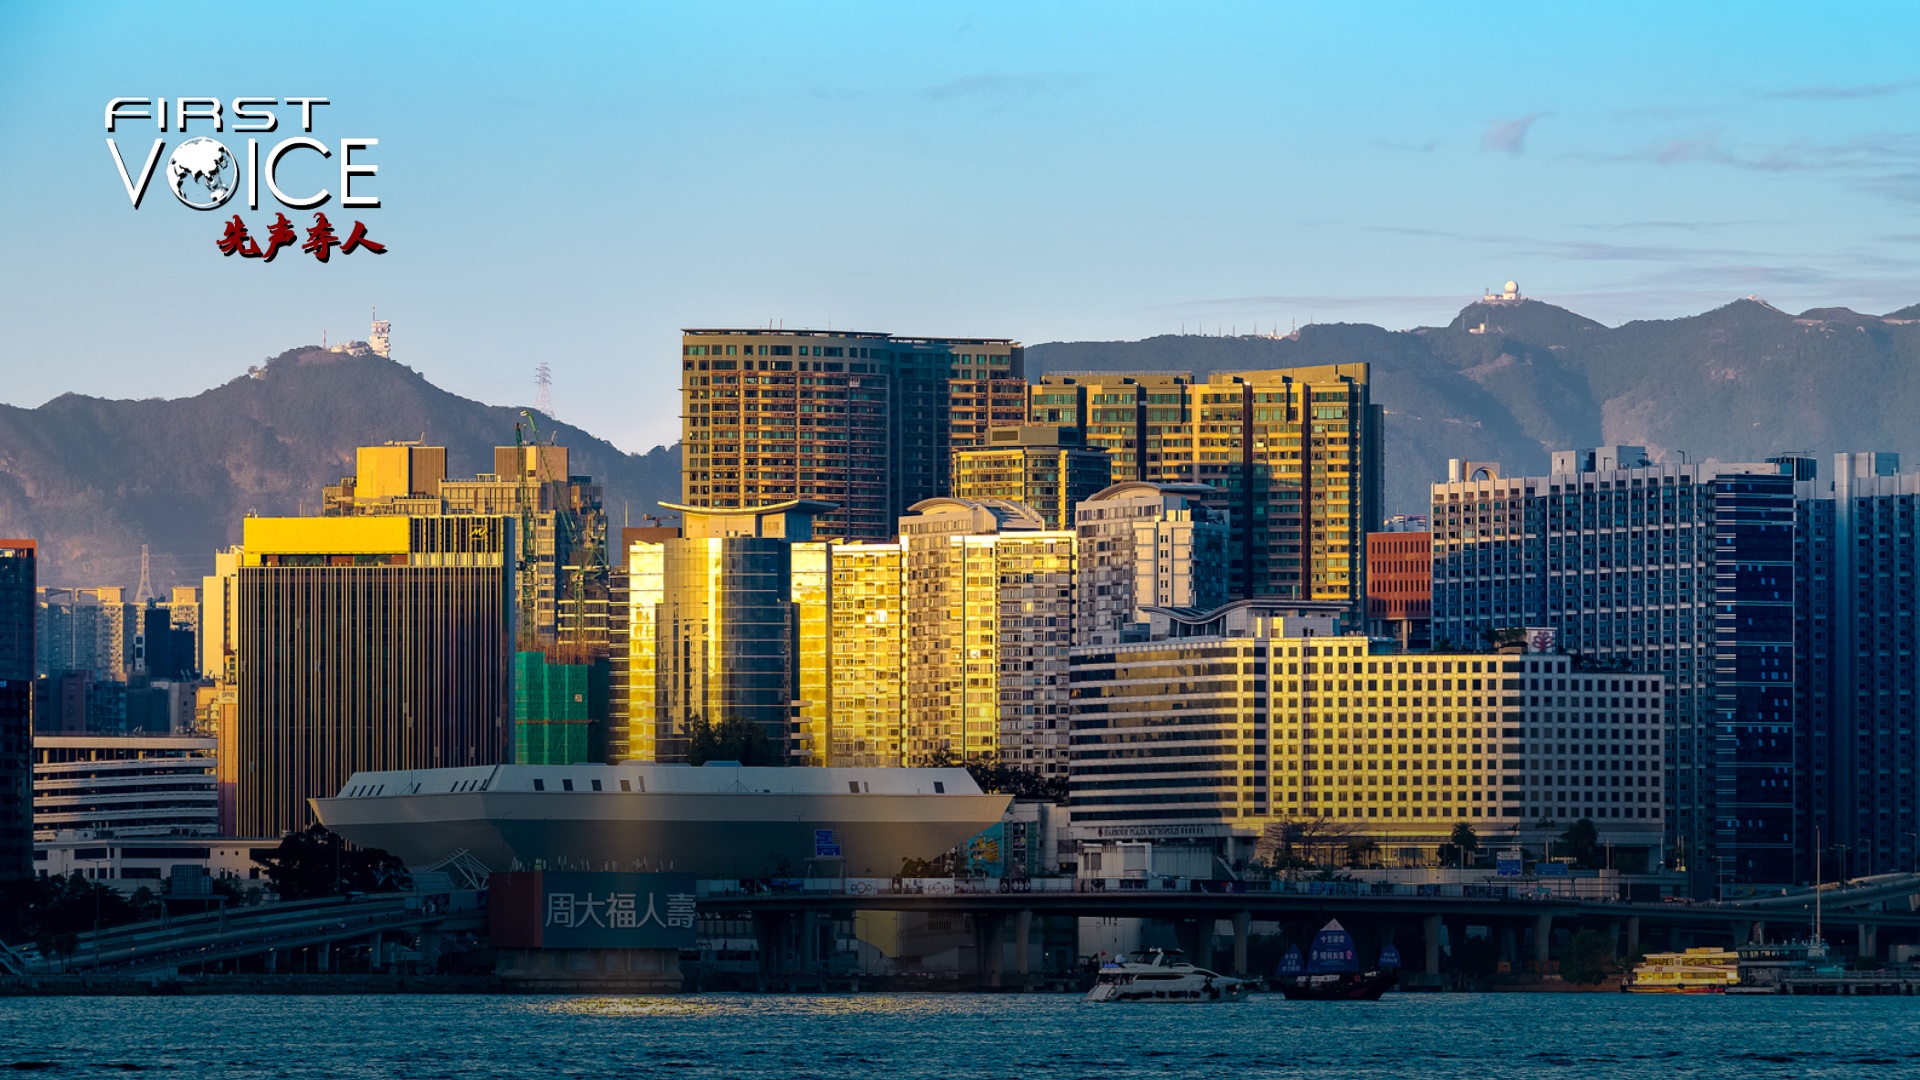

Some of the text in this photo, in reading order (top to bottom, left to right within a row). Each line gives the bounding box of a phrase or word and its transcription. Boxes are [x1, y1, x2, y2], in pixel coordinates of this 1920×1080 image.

[1130, 828, 1147, 836] PLAZA
[545, 892, 697, 929] 周大福人壽
